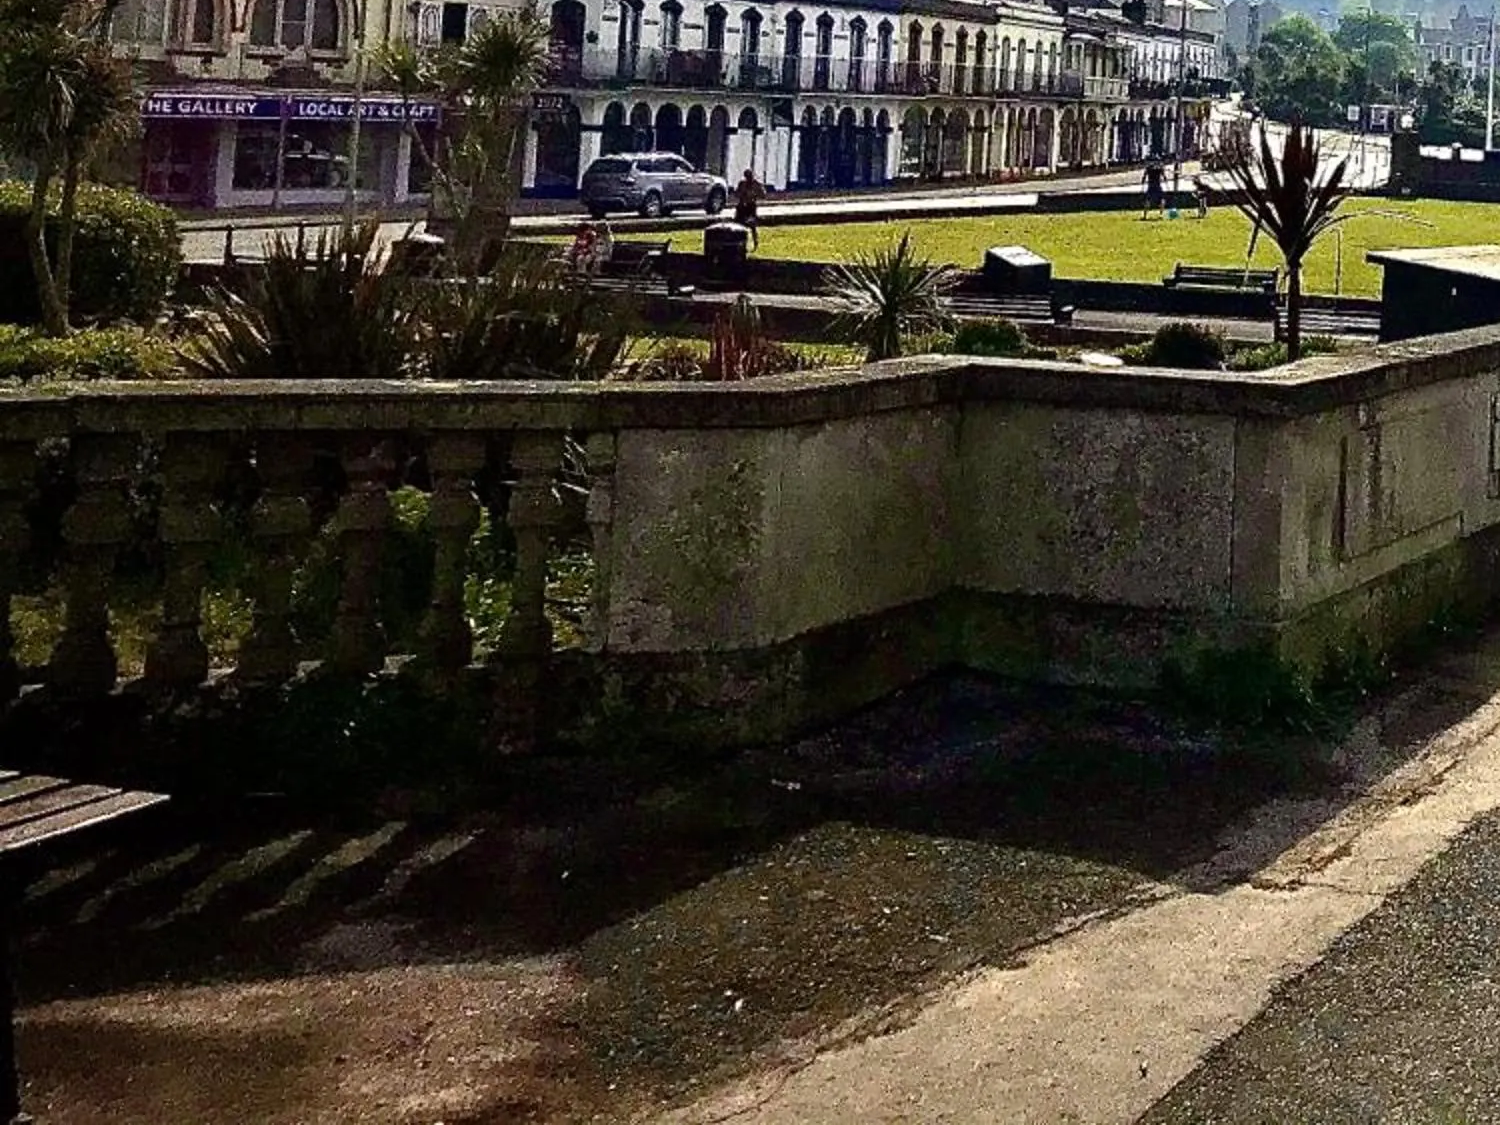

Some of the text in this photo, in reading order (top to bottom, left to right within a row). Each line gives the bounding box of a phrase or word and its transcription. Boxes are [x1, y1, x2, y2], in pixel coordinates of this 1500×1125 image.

[178, 100, 257, 114] GALLERY
[299, 102, 345, 116] LOCAL
[377, 104, 389, 116] &
